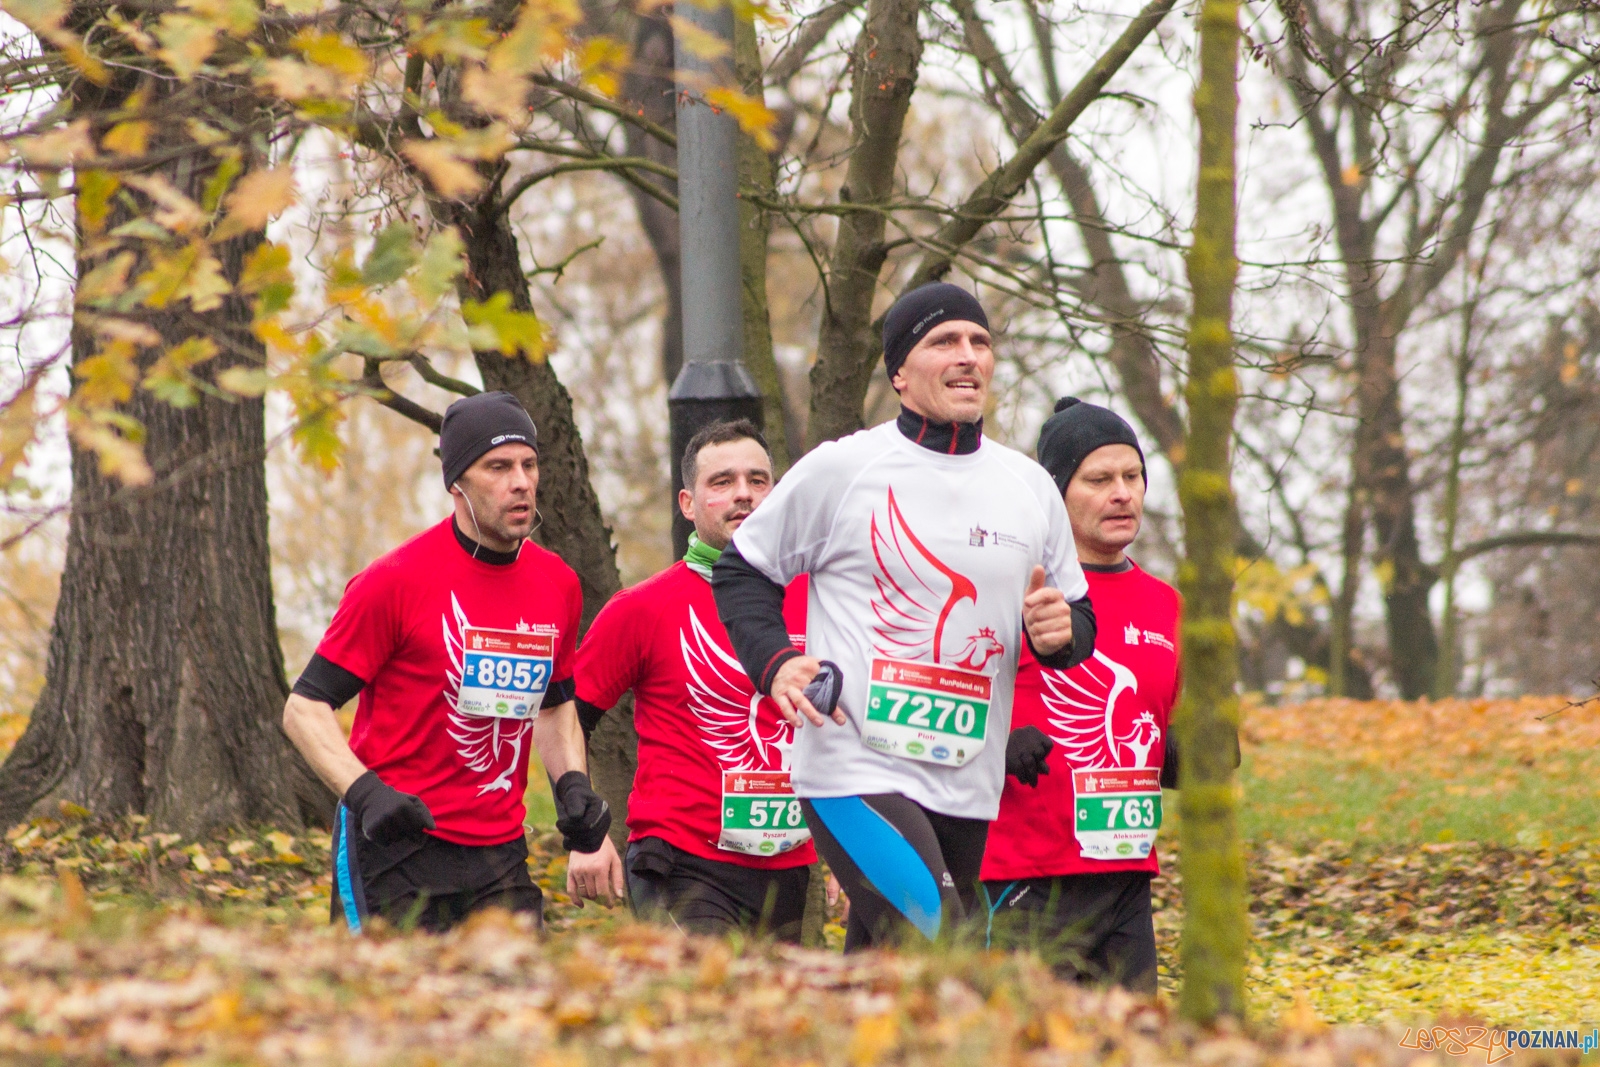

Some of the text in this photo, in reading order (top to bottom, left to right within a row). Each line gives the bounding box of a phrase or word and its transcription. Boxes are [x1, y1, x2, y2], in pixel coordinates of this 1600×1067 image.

[992, 532, 999, 545] 1
[485, 637, 490, 648] 1
[1143, 630, 1150, 644] 1
[466, 658, 546, 690] E 8952
[899, 669, 905, 680] 1
[940, 677, 984, 694] RunPoland.org
[495, 692, 525, 701] Arkadiusz
[870, 690, 976, 735] C 7270
[917, 732, 936, 741] Piotr
[748, 780, 754, 790] 1
[1099, 778, 1105, 789] 1
[725, 800, 802, 827] C 578
[1078, 798, 1155, 828] C 763
